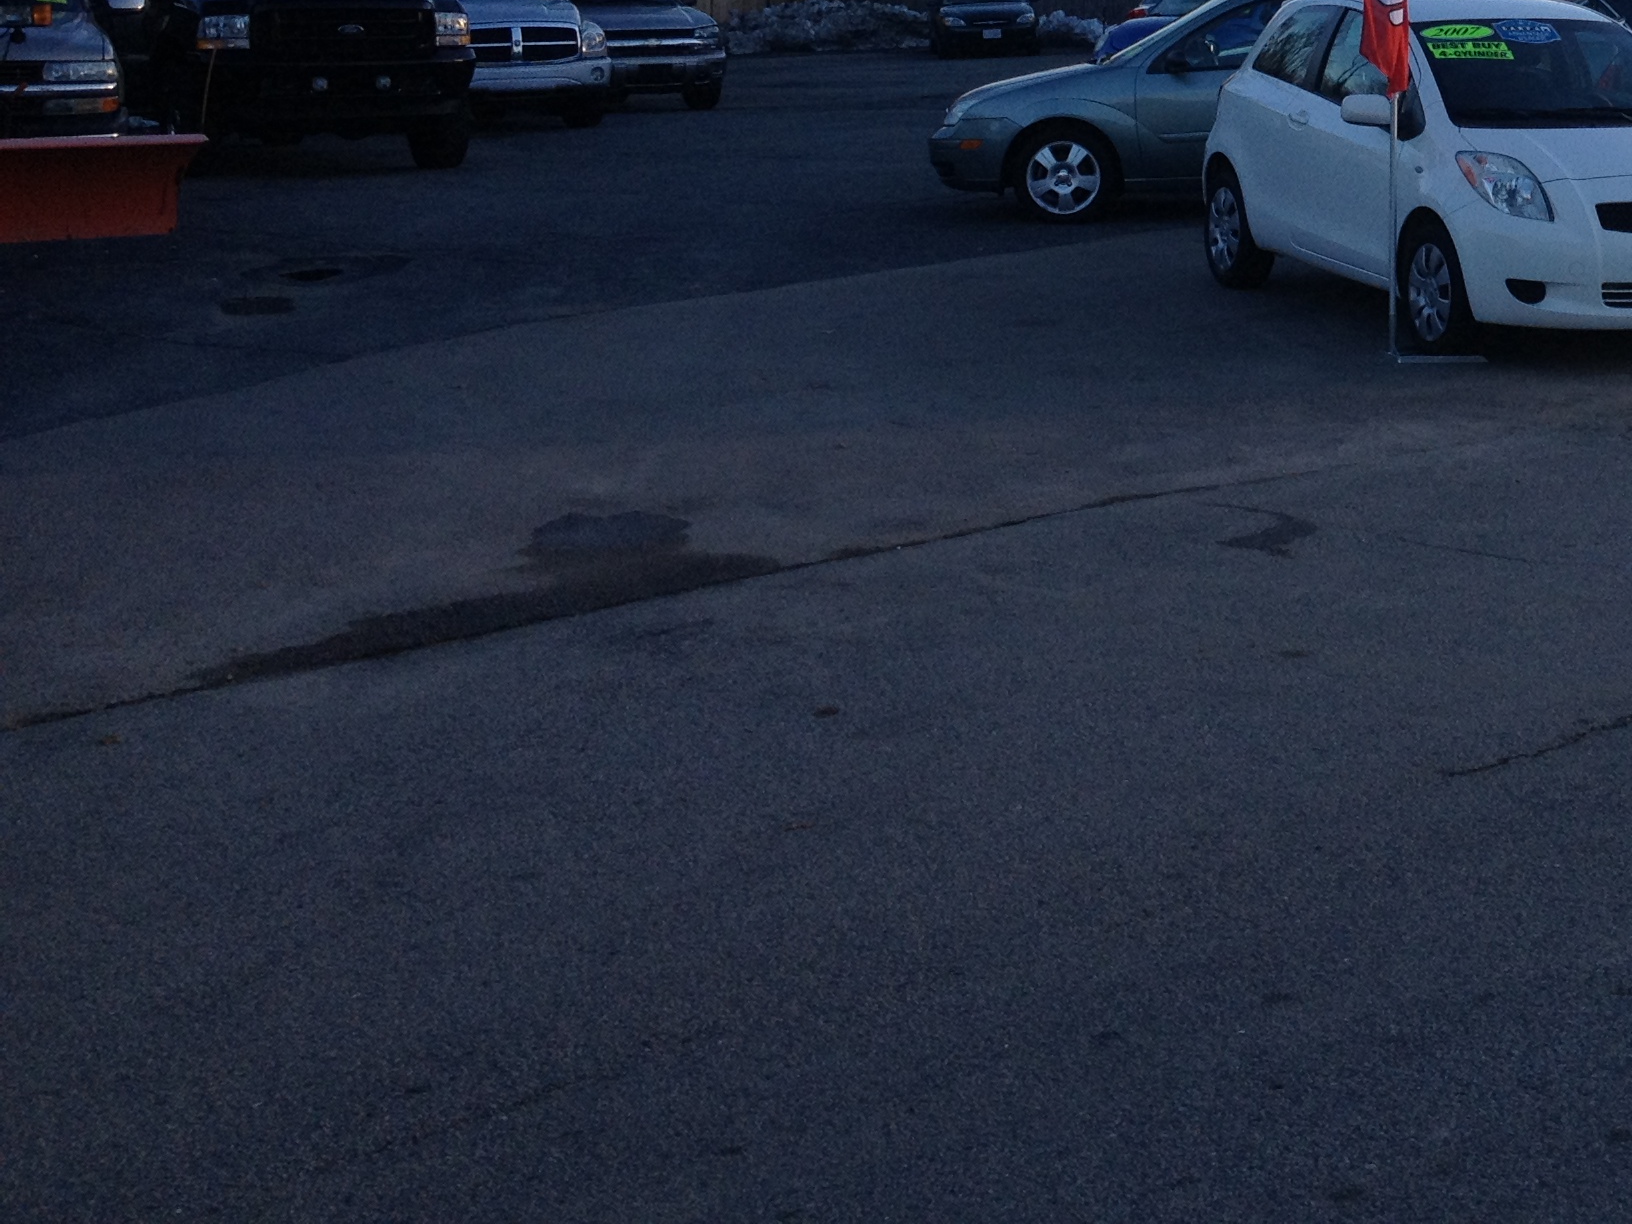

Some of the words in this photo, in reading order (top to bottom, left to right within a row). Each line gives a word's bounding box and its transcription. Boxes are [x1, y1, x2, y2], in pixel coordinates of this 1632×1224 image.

[1430, 25, 1482, 38] 2007
[1431, 42, 1468, 51] BEST
[1472, 41, 1502, 50] BUY
[1438, 49, 1511, 59] 4-CYLINDER
